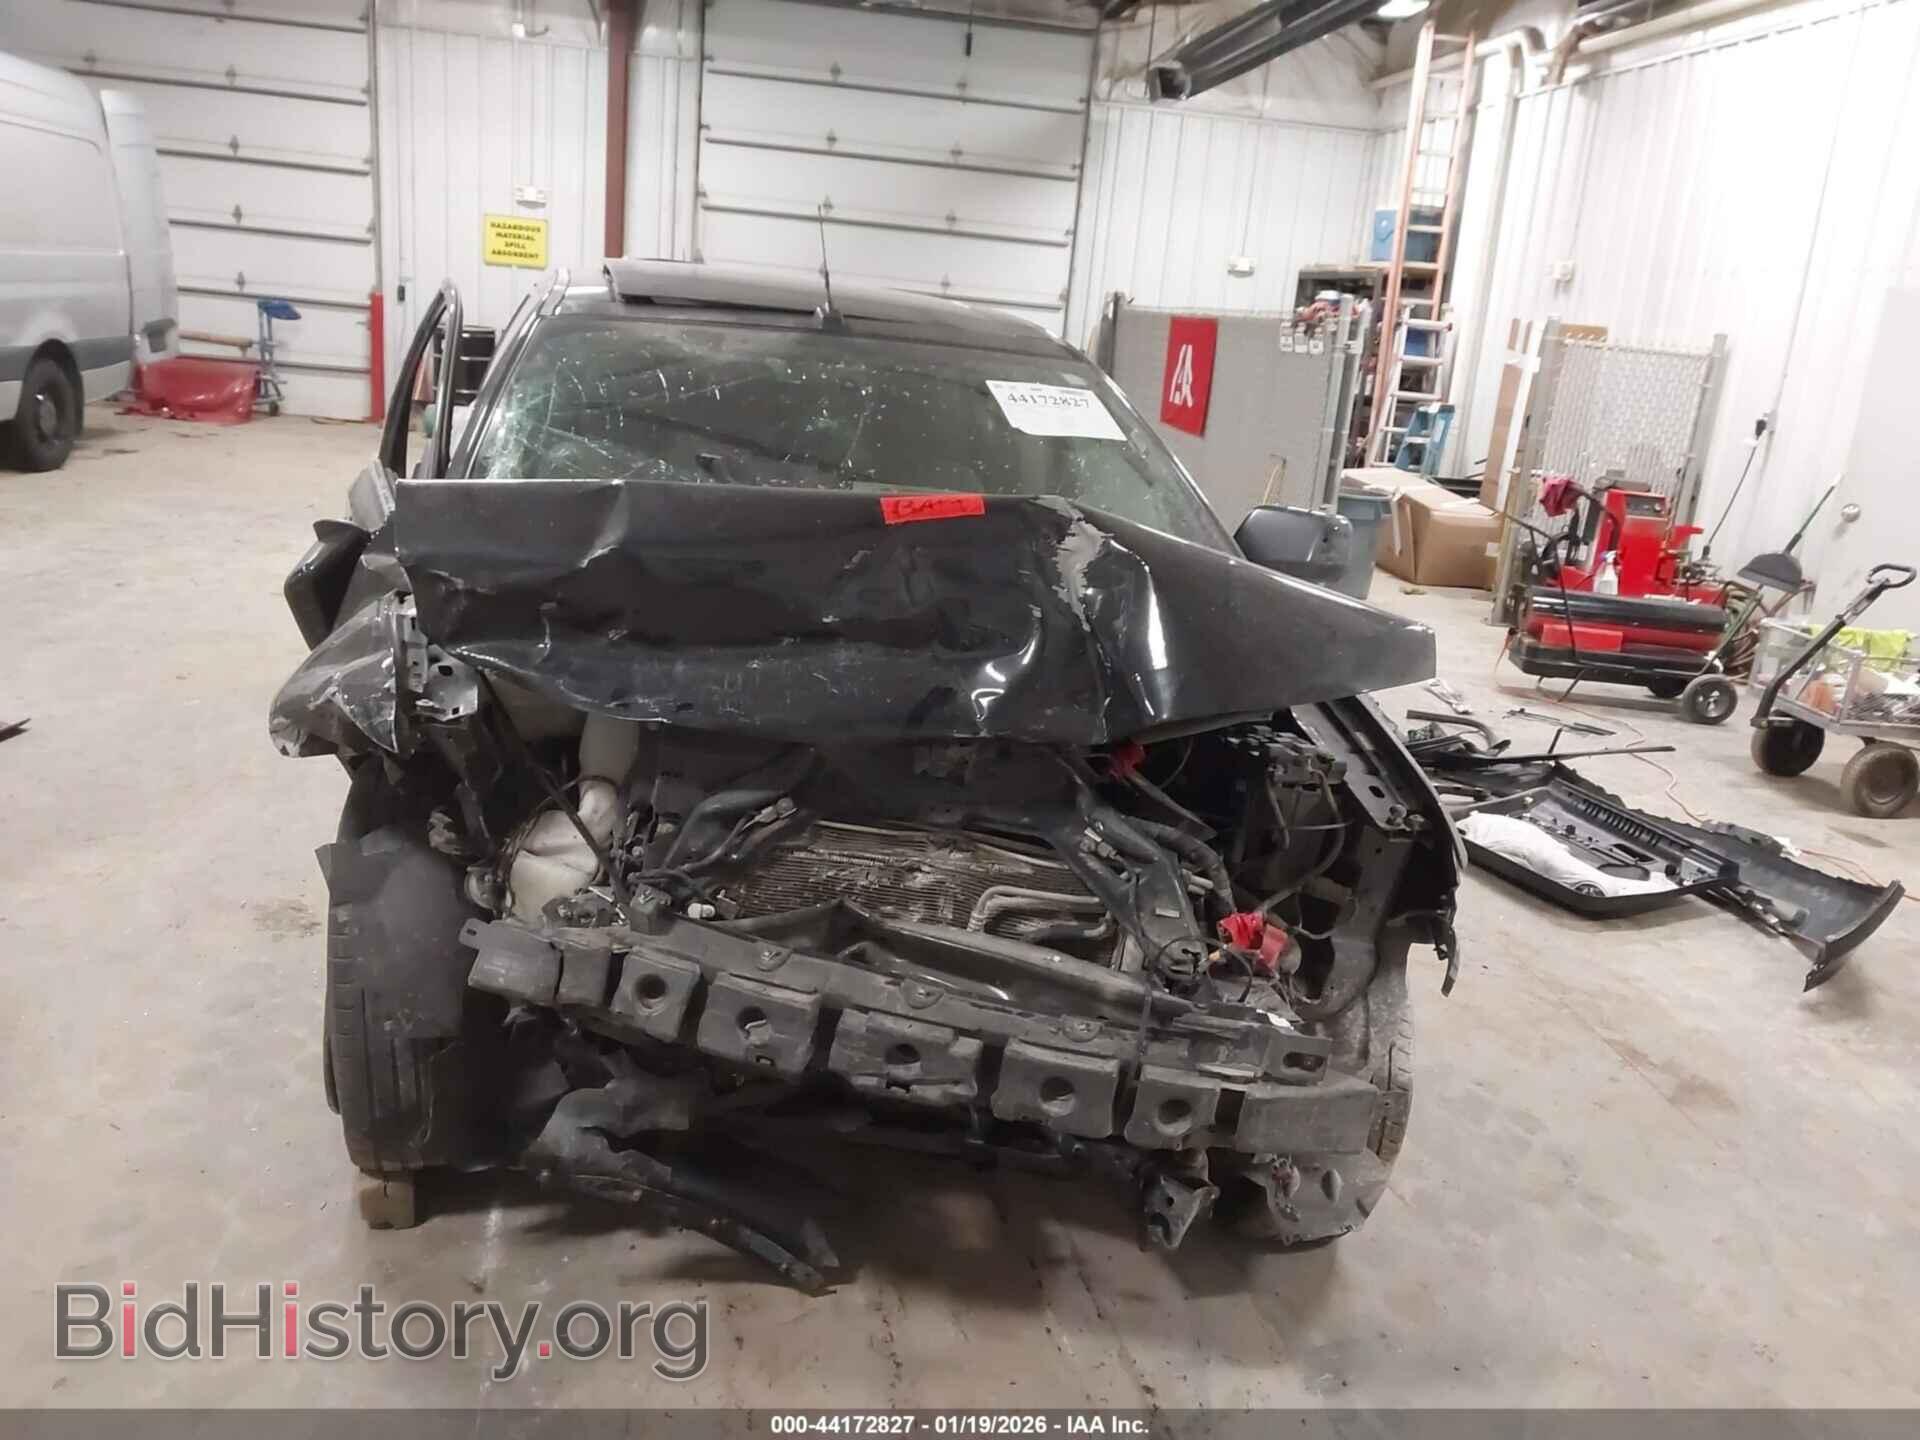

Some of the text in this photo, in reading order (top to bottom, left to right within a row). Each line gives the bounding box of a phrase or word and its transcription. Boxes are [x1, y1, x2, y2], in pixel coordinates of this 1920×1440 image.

[490, 222, 541, 232] HAZARDOUS
[496, 232, 536, 241] MATERIAL
[504, 241, 526, 249] SPILL
[491, 249, 539, 259] ABSORBENT
[1007, 393, 1089, 408] 44172827
